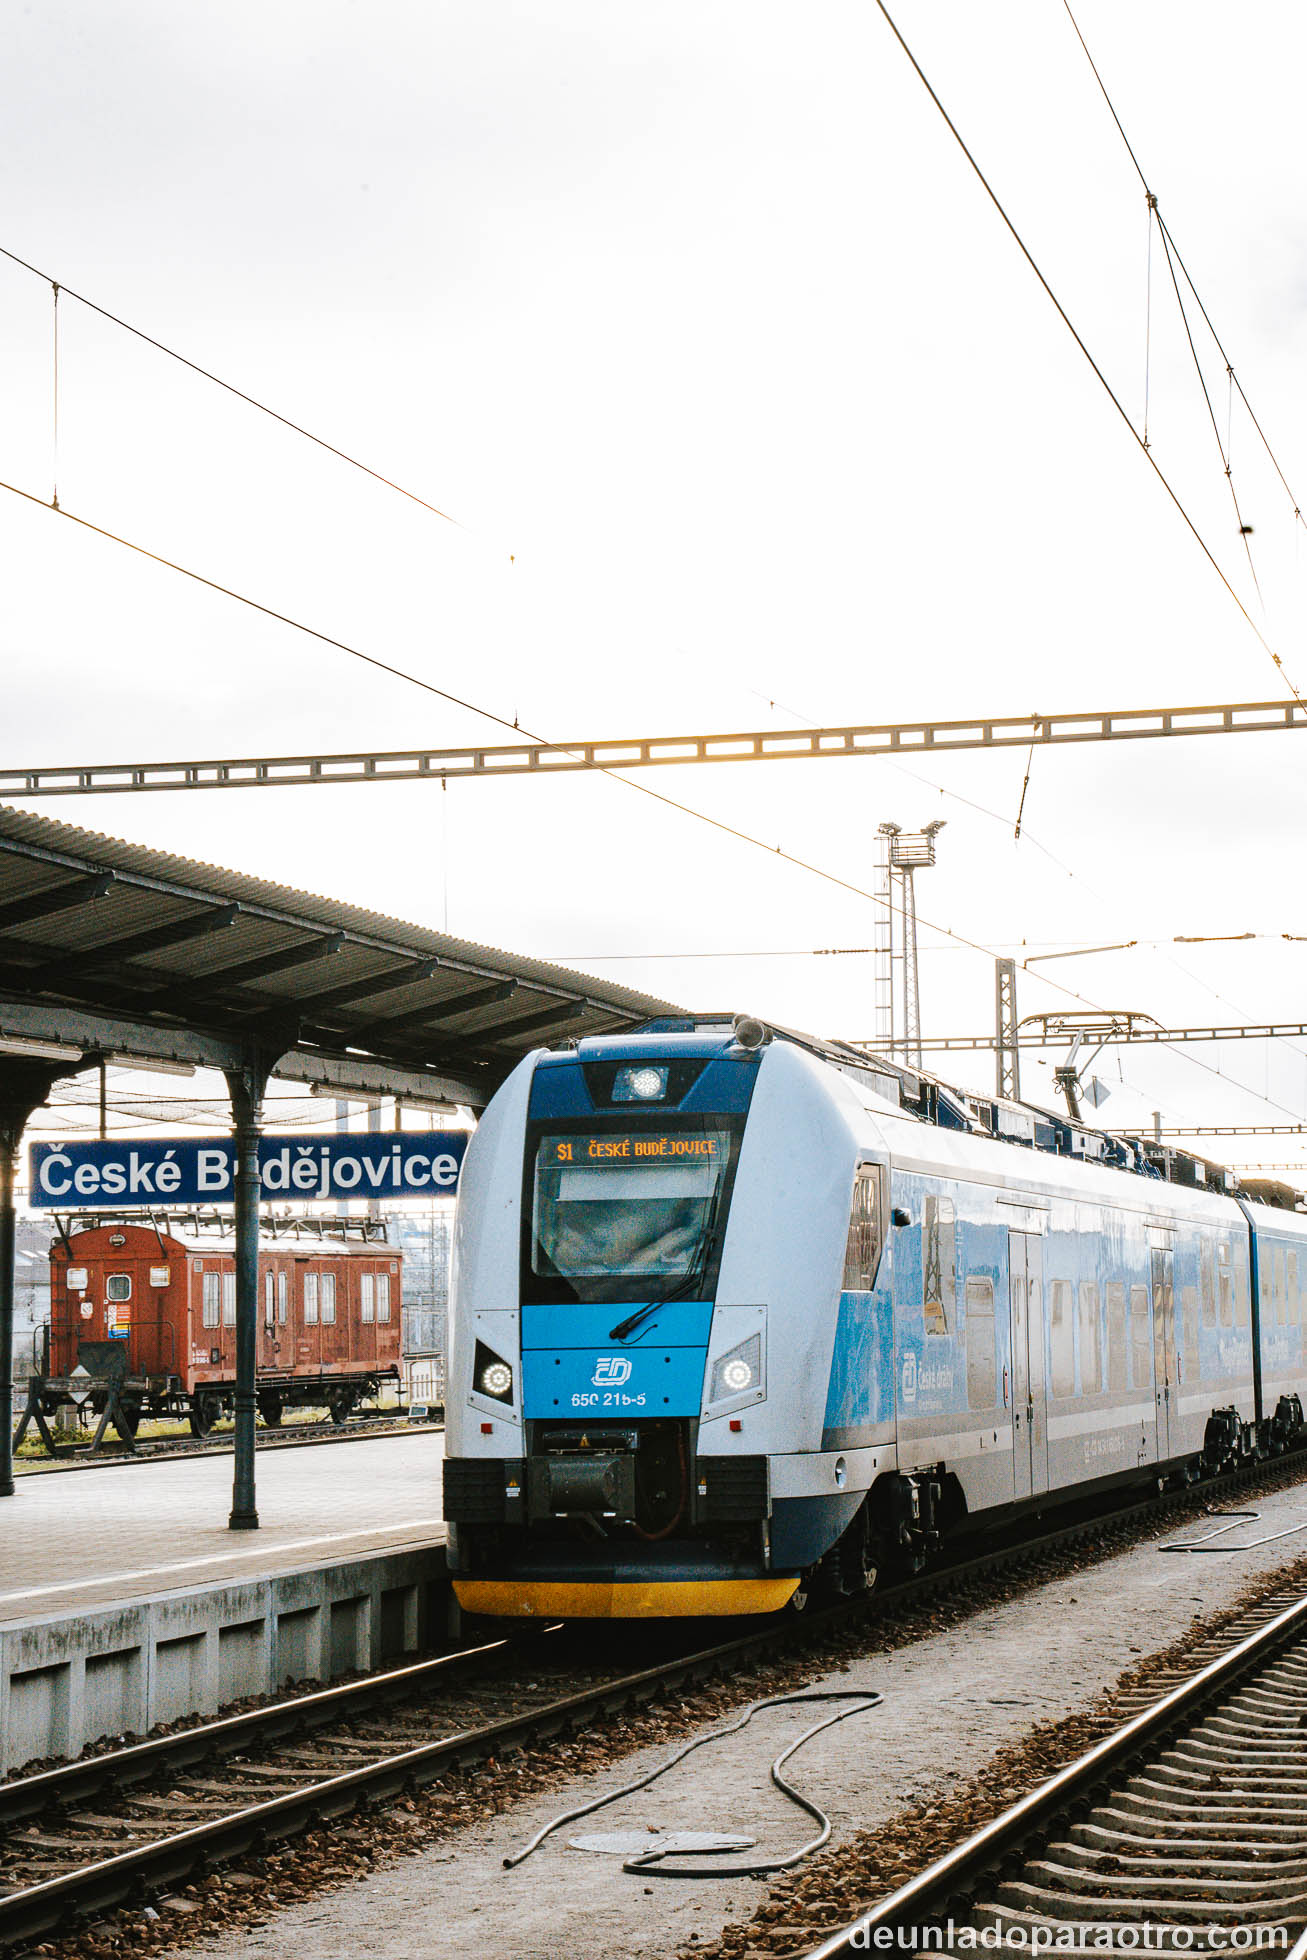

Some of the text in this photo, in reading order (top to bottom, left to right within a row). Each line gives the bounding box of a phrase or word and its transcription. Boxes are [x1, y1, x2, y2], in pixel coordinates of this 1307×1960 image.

[557, 1138, 718, 1161] S1 ČESKÉ BUDĚJOVICE
[39, 1143, 458, 1200] České Bdějovice
[571, 1393, 599, 1406] 650
